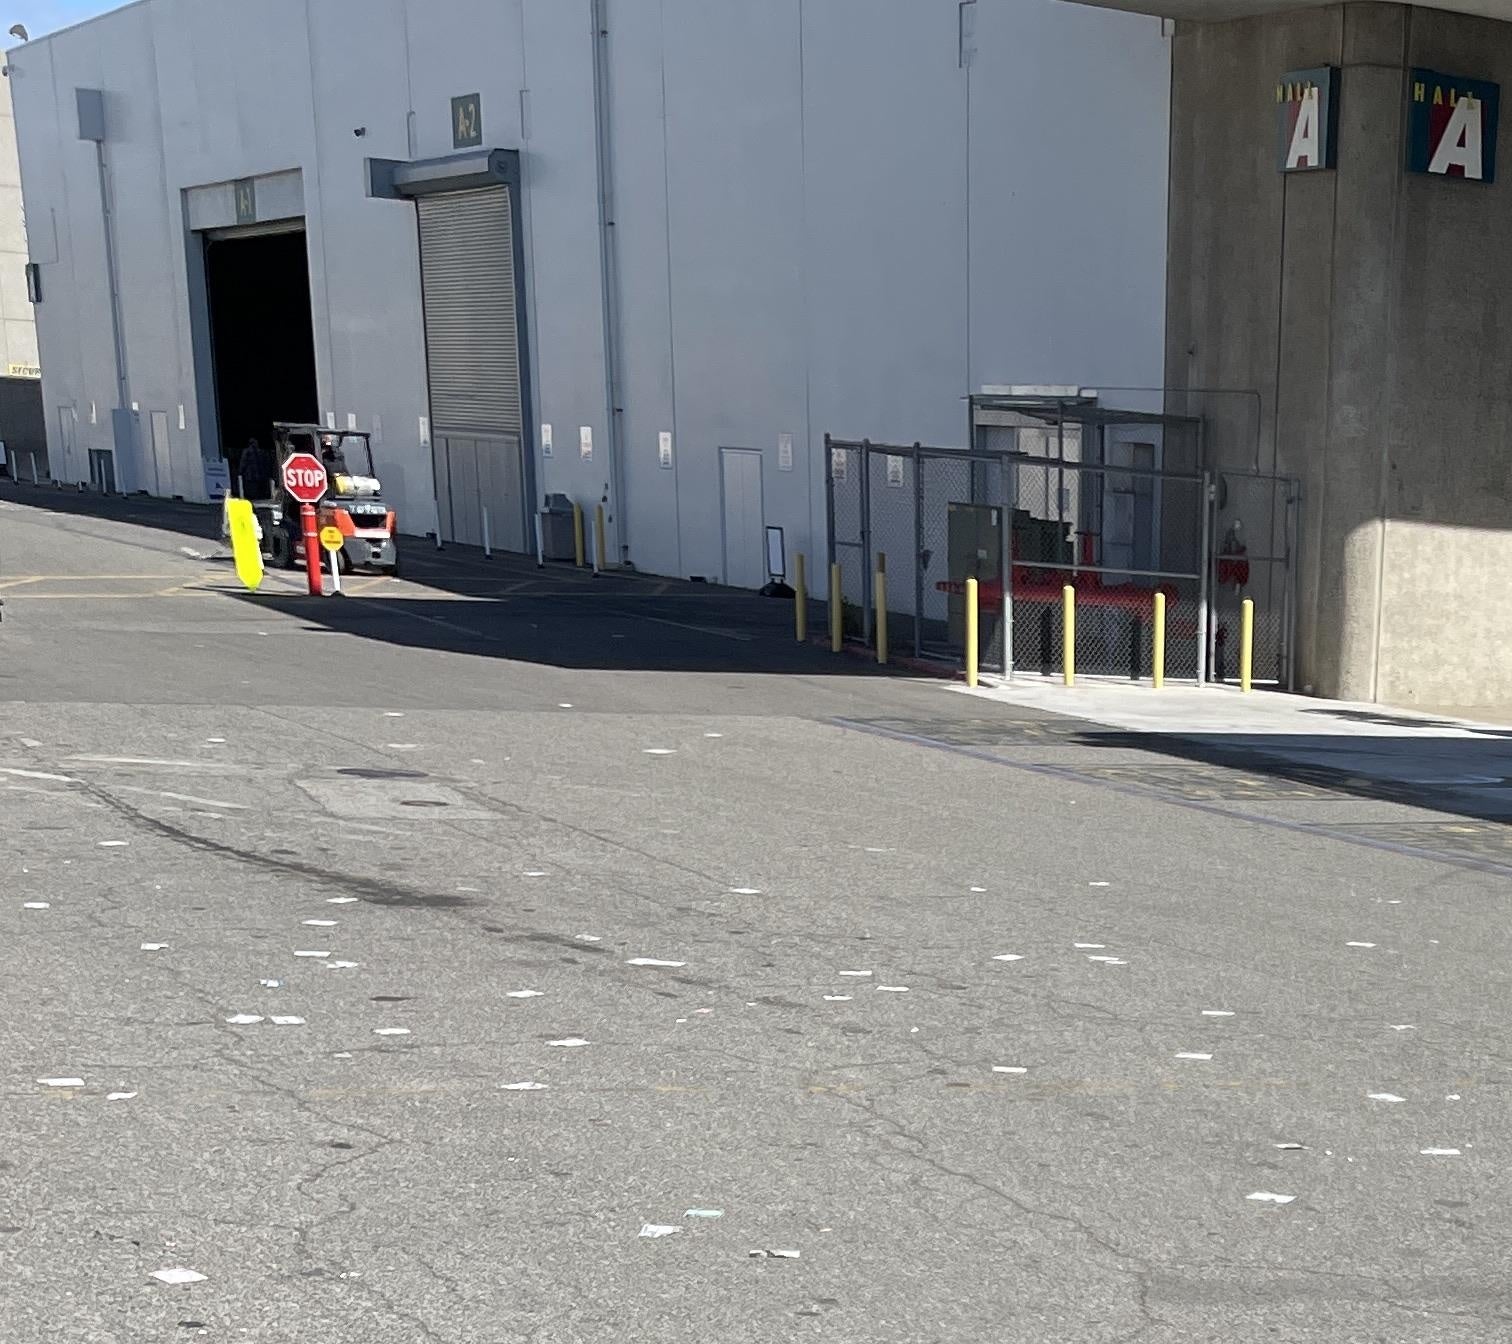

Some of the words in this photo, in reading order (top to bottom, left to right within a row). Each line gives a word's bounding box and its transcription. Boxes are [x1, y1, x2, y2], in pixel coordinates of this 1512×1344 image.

[1414, 82, 1475, 110] HALL
[1286, 86, 1318, 169] A
[1428, 96, 1482, 179] A
[286, 469, 325, 488] STOP
